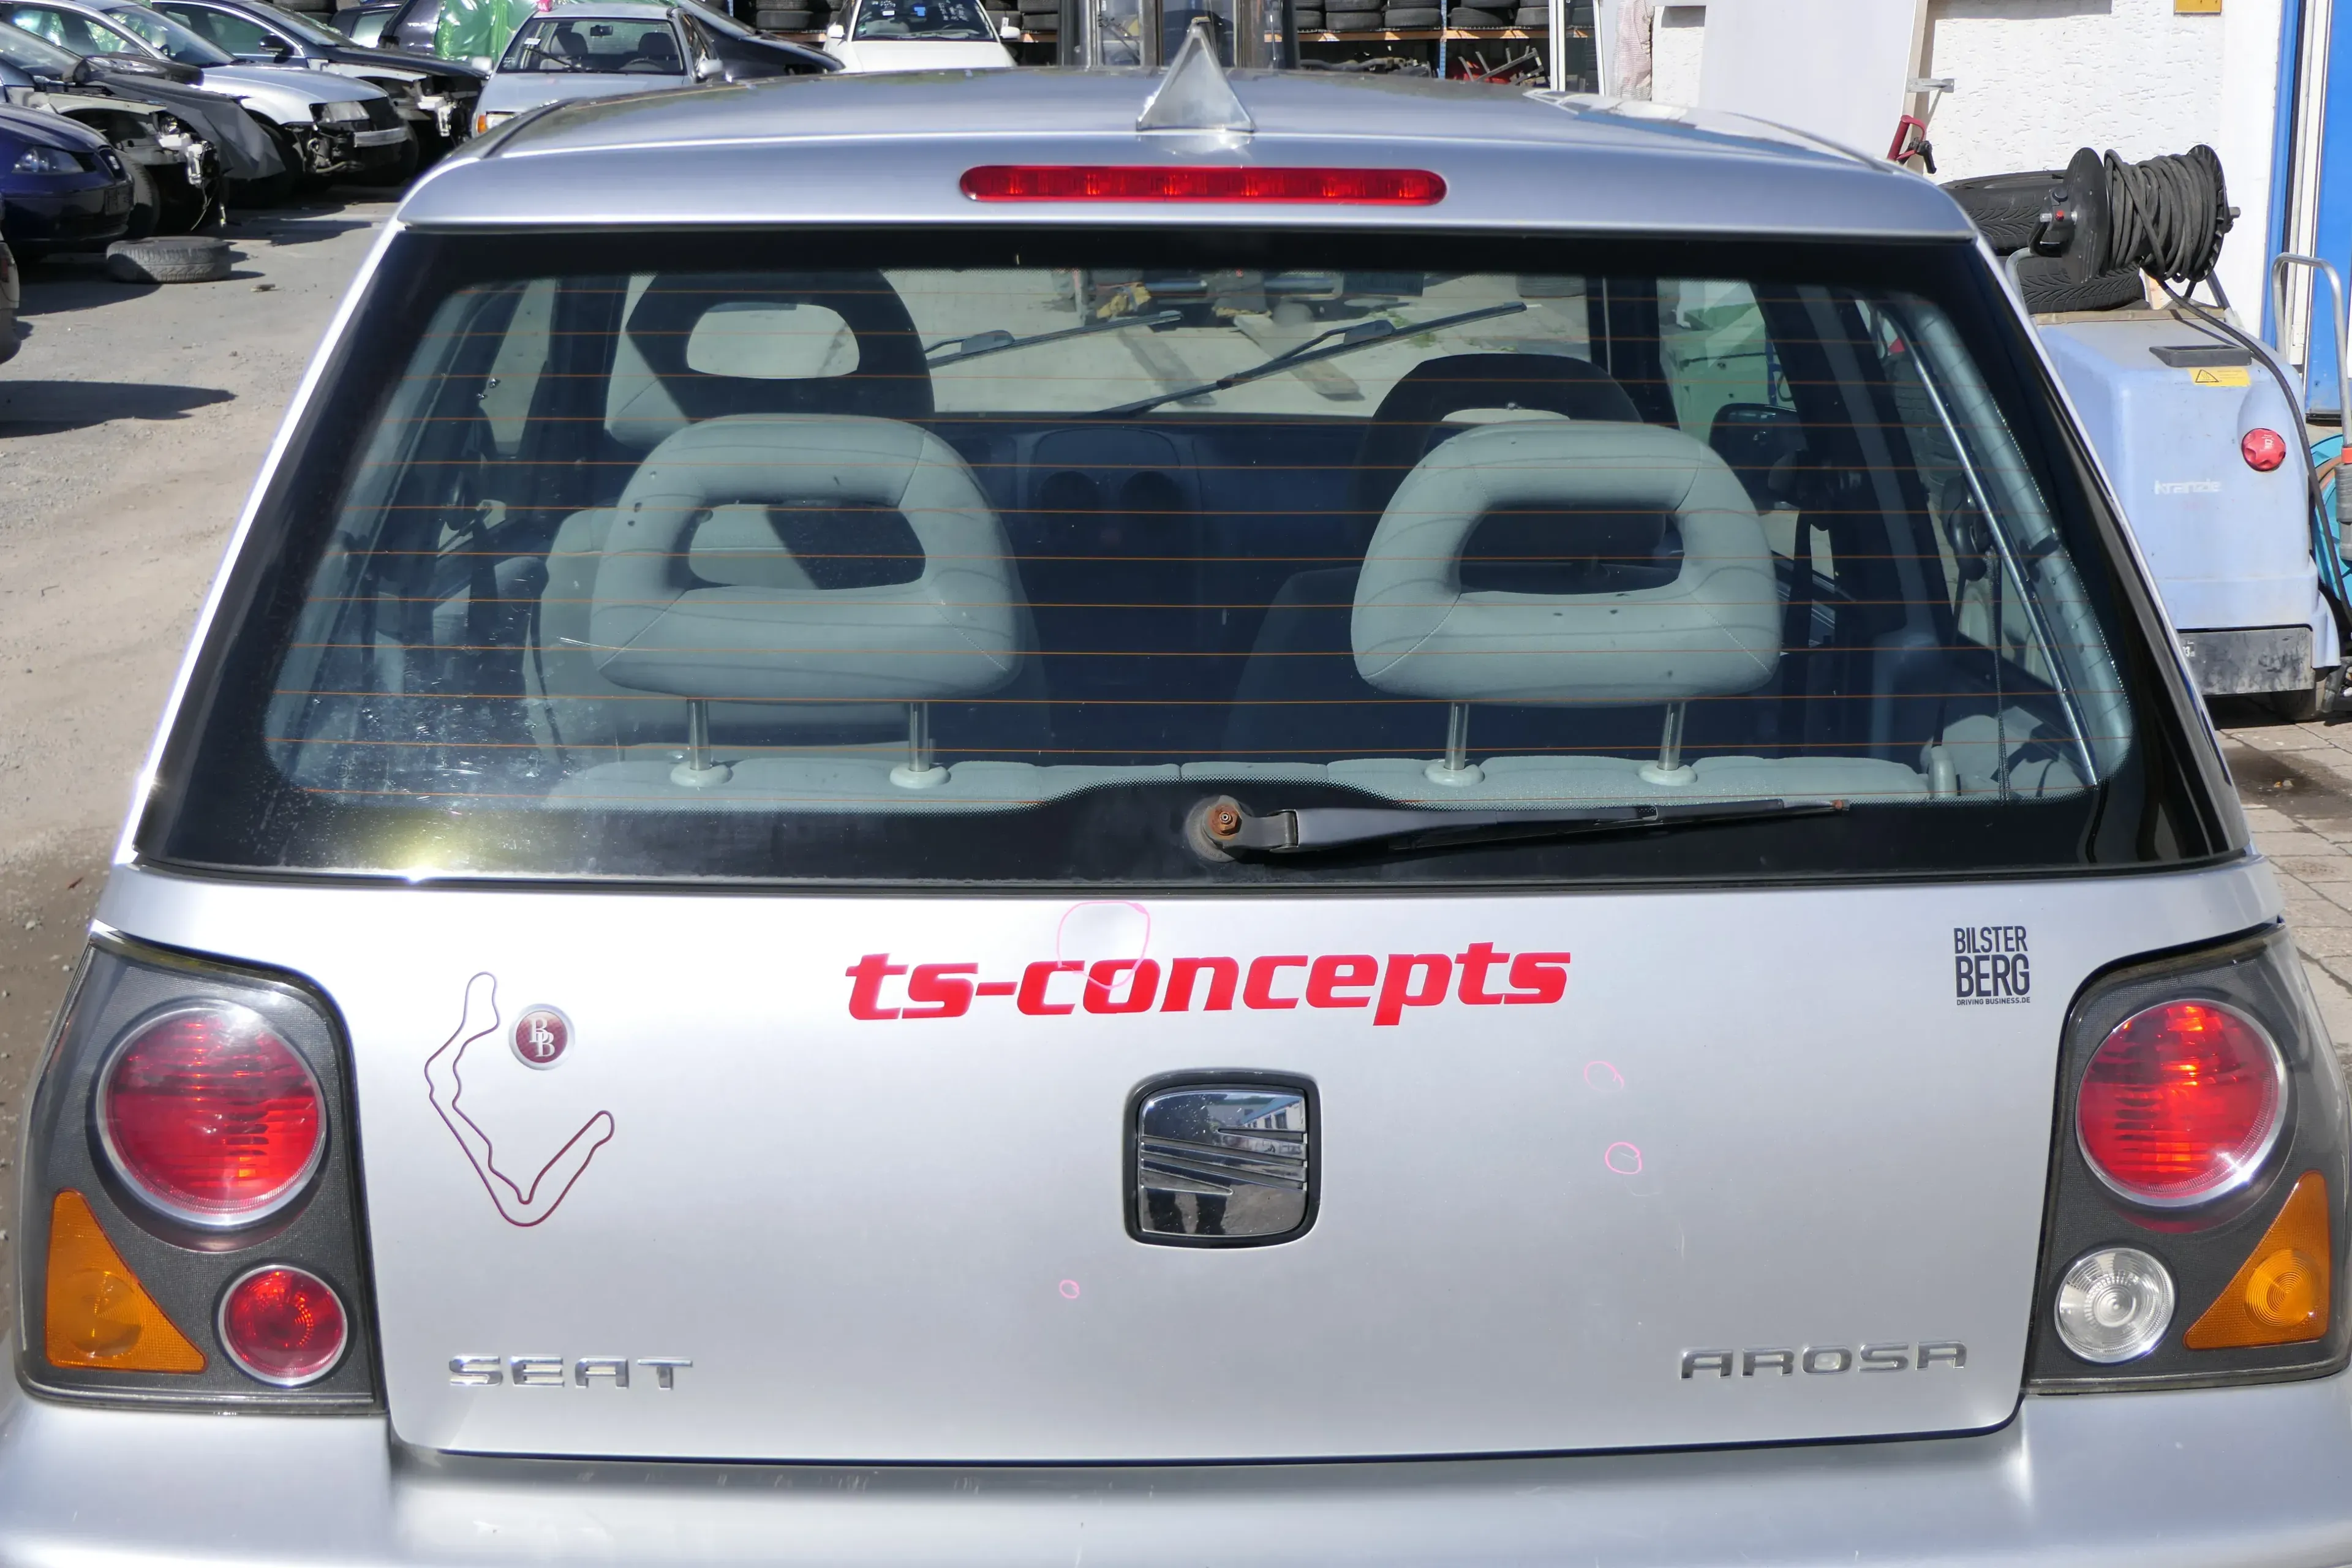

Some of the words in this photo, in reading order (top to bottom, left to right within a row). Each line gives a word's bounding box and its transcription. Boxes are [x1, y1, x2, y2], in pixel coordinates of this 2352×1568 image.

[1954, 925, 2028, 954] BILSTER
[845, 942, 1570, 1026] ts-concepts
[1955, 953, 2030, 998] BERG
[1985, 997, 2030, 1005] BUSINESS.DE
[449, 1355, 693, 1390] SEAT
[1679, 1340, 1967, 1380] AROSA
